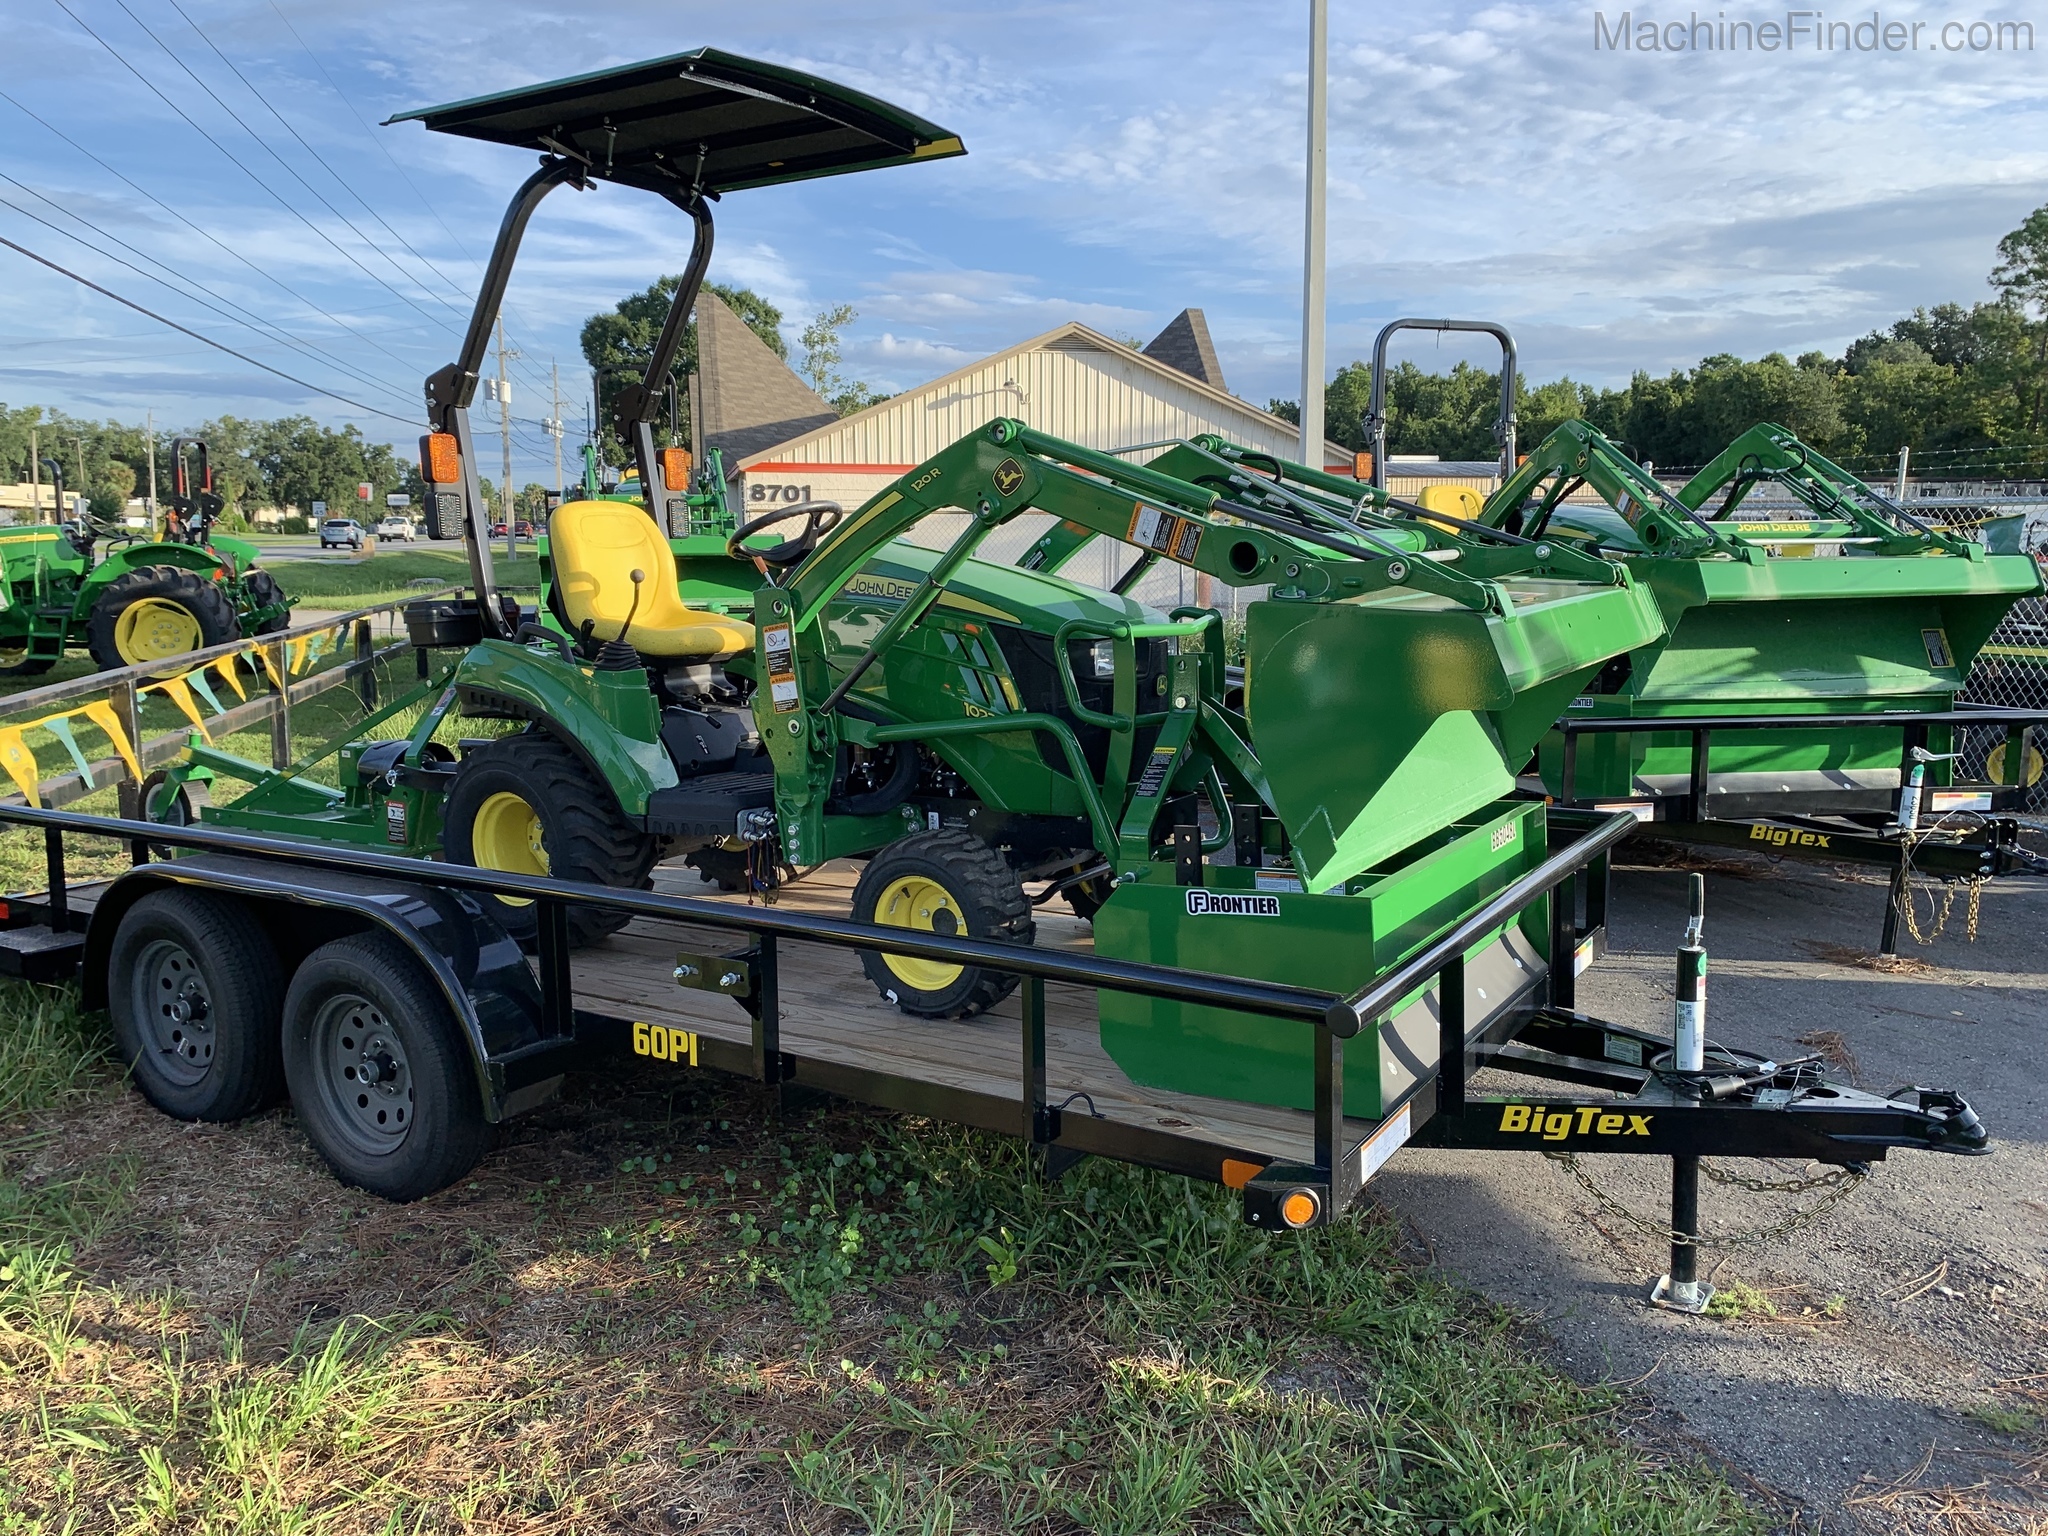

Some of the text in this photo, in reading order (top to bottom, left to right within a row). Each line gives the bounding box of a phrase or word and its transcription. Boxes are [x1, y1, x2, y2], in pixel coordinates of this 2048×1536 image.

[750, 484, 811, 502] 8701
[851, 579, 916, 598] JOHN DEE
[1749, 823, 1831, 848] BigTex
[1188, 891, 1278, 914] FRONTIER
[633, 1021, 698, 1067] 60PI
[1499, 1105, 1654, 1140] BigTex
